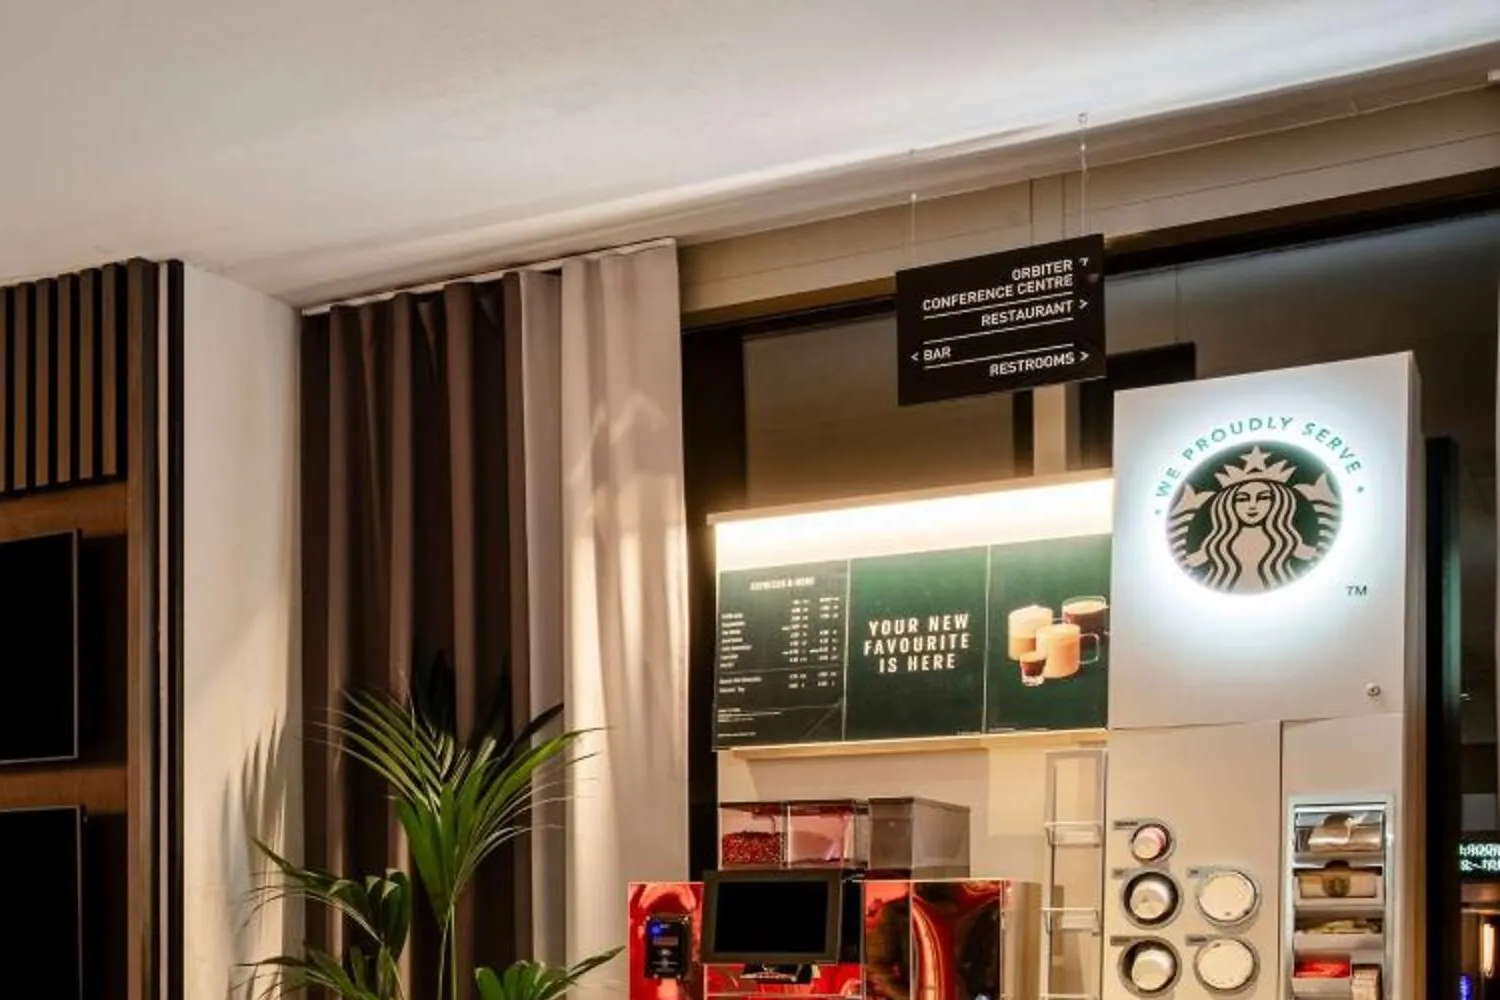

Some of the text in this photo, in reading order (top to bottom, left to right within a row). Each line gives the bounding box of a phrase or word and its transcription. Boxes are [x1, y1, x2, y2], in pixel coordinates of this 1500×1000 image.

[1011, 259, 1073, 281] ORBITER
[922, 273, 1073, 311] CONFERENCE CENTRE
[981, 299, 1073, 327] RESTAURANT
[923, 346, 951, 361] BAR
[989, 351, 1075, 377] RESTROOMS
[1156, 416, 1363, 497] WE PROUDLY SERVE
[1346, 585, 1367, 596] TM
[868, 612, 969, 636] YOUR NEW
[863, 633, 970, 656] FAVOURITE
[879, 653, 956, 673] IS HERE
